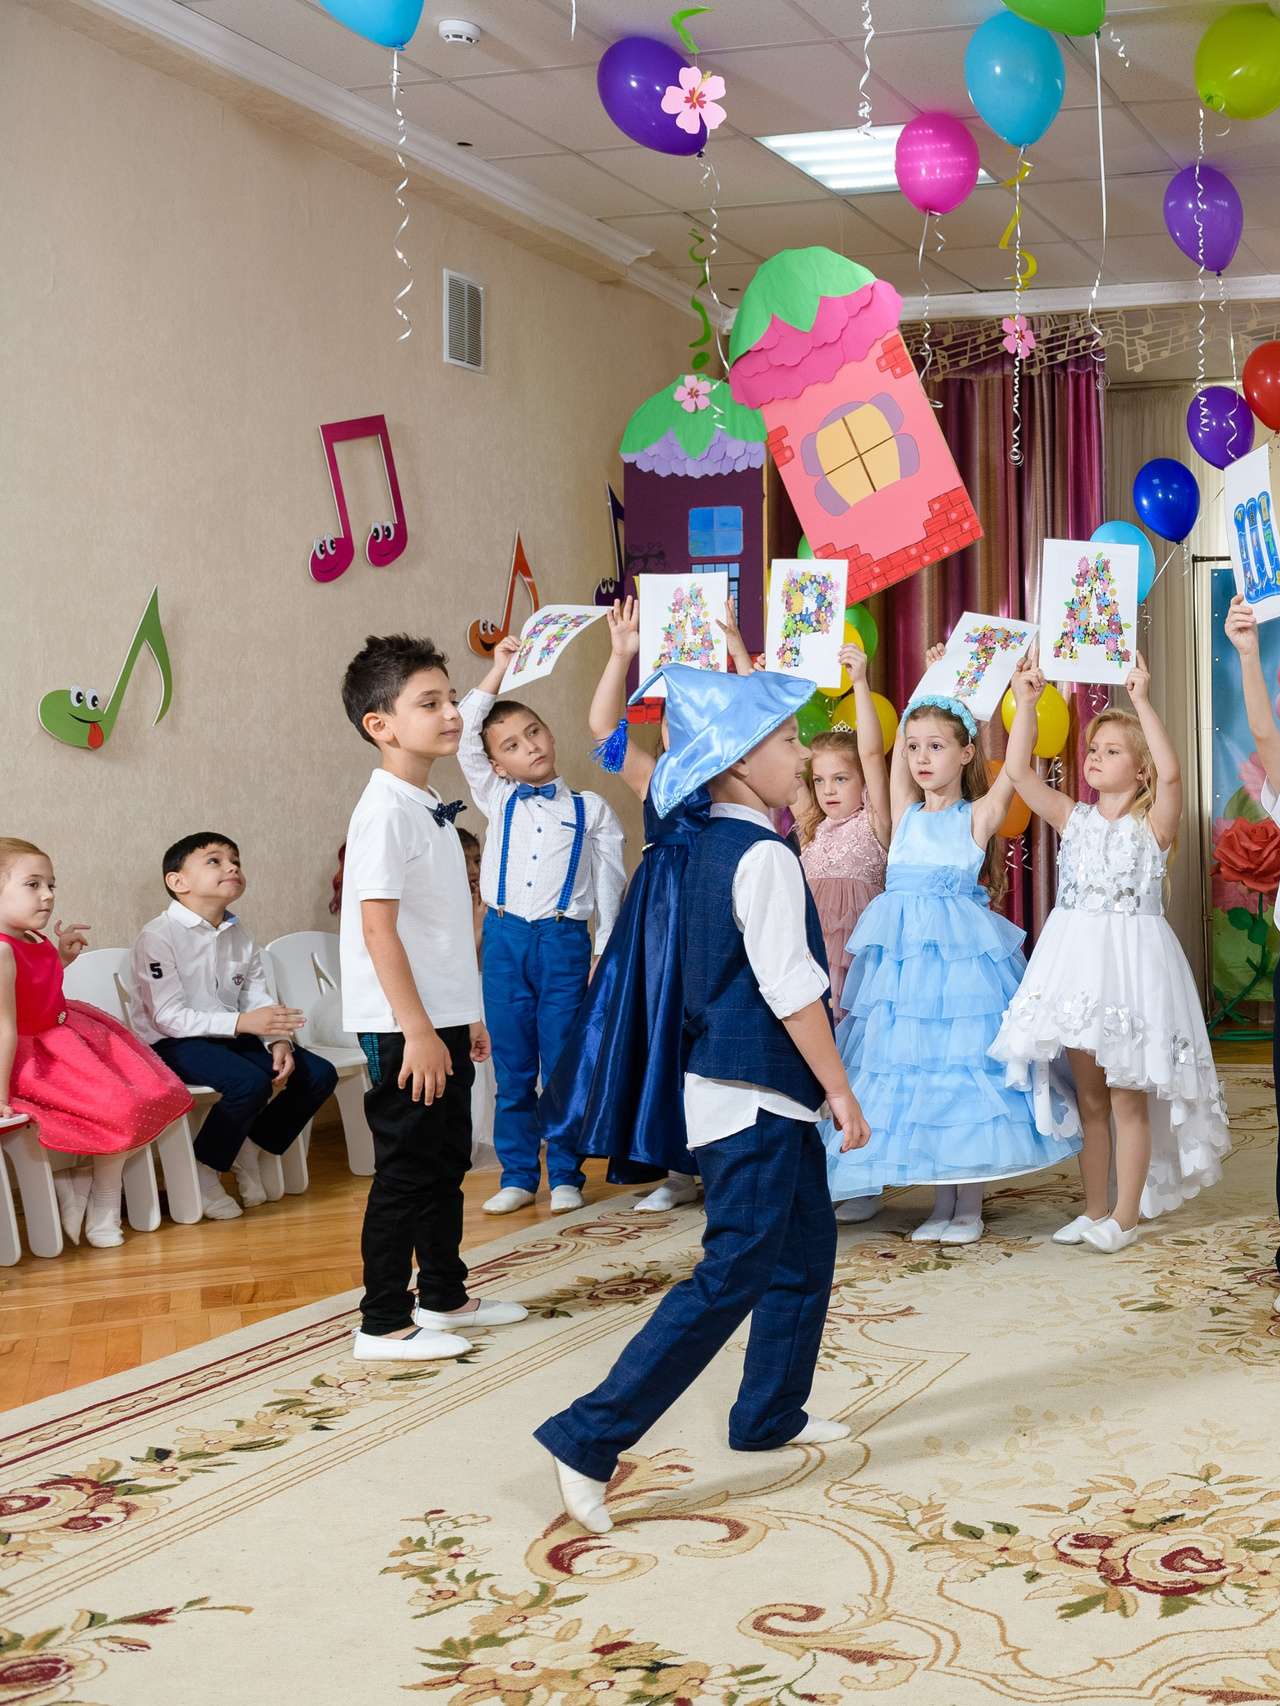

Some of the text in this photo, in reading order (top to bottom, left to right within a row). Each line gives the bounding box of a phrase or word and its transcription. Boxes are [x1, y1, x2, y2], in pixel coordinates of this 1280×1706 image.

[652, 582, 721, 671] А
[777, 568, 839, 669] Р
[1053, 552, 1131, 668] А
[953, 624, 1028, 698] Т
[150, 963, 163, 979] 5
